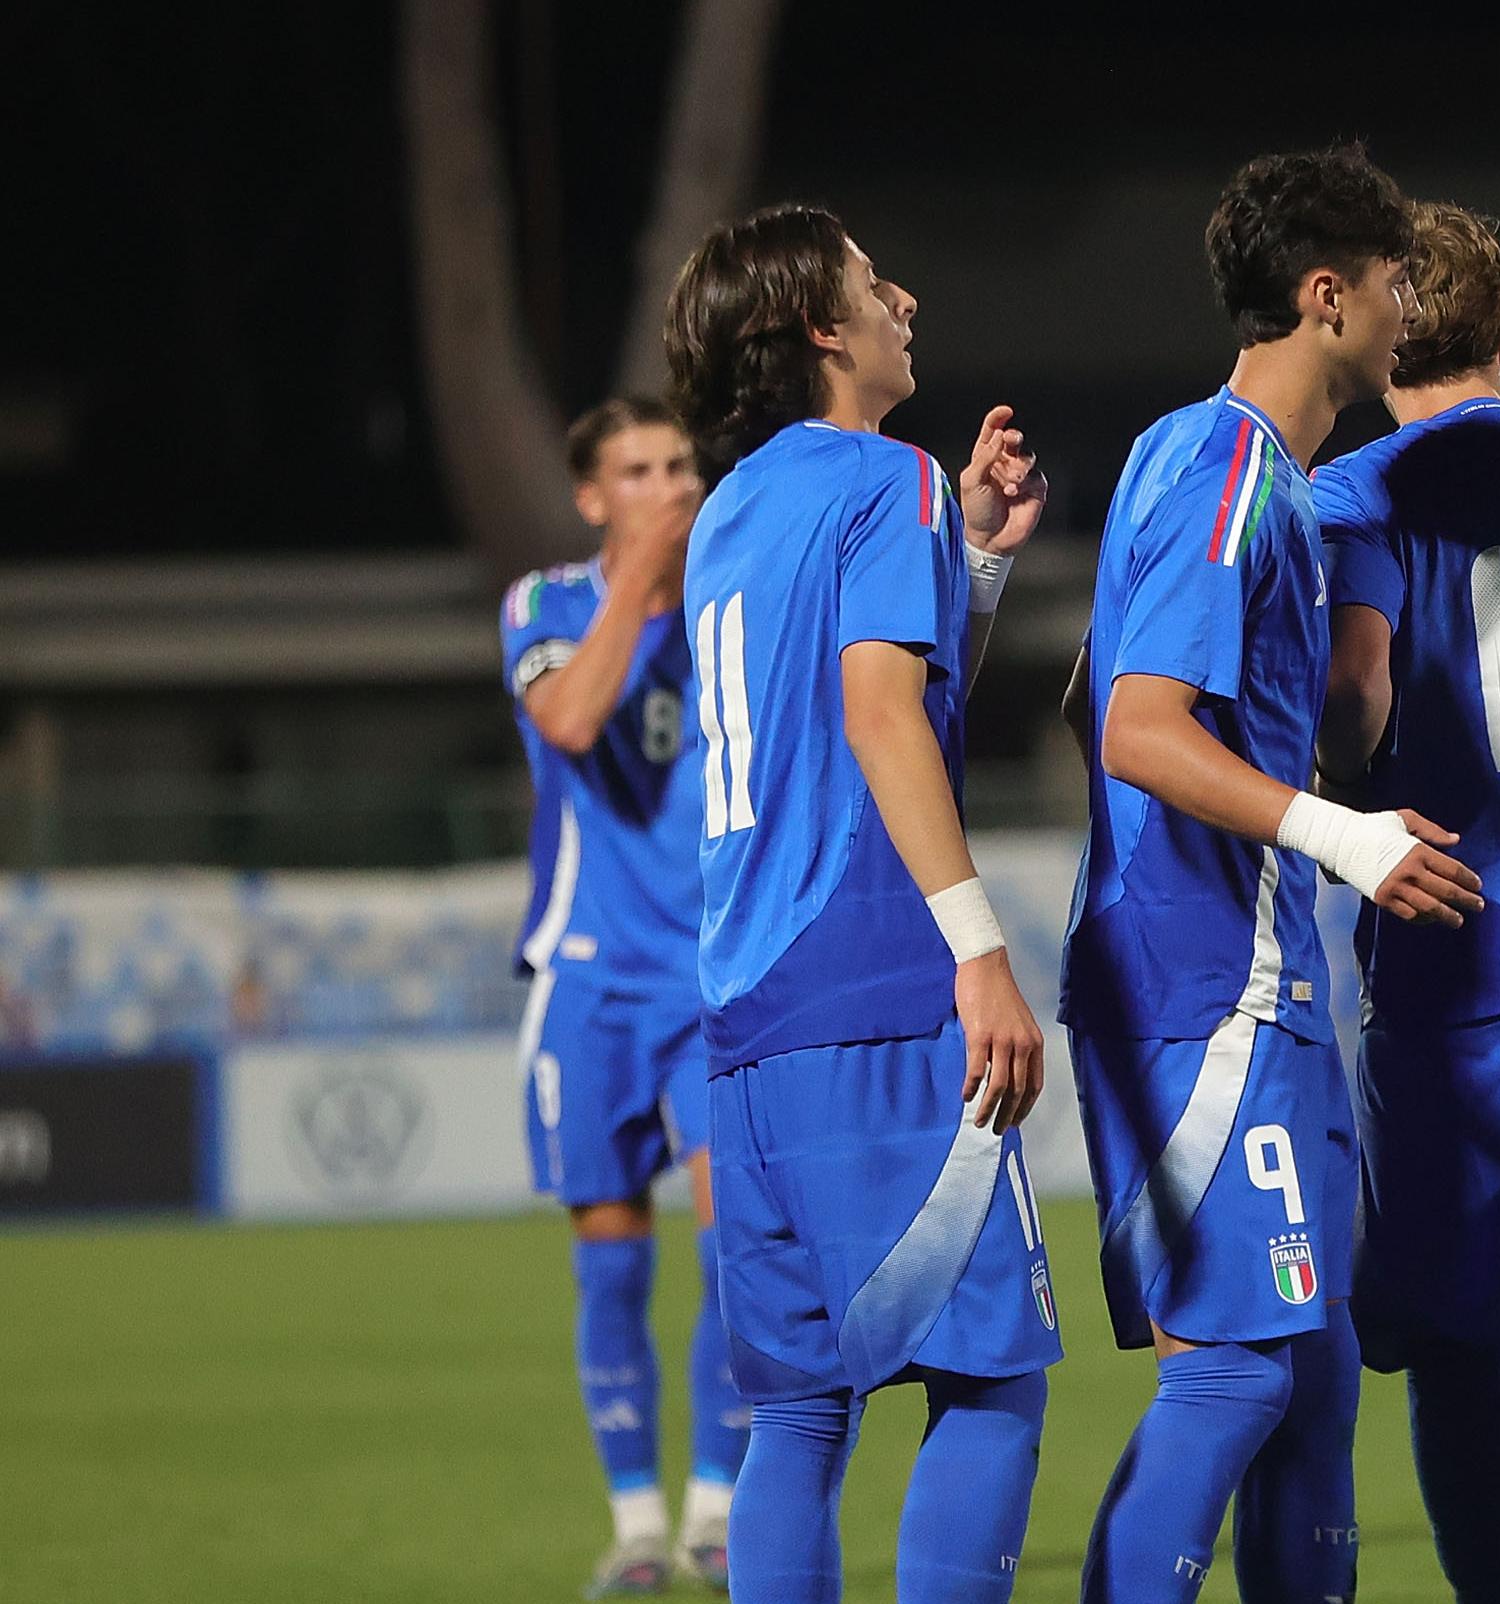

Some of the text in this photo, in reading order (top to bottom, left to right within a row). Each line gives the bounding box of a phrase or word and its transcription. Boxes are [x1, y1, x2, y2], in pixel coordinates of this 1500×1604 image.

[642, 688, 684, 764] 8
[697, 591, 756, 840] 11
[1244, 1124, 1306, 1225] 9
[1273, 1246, 1309, 1265] ITALIA
